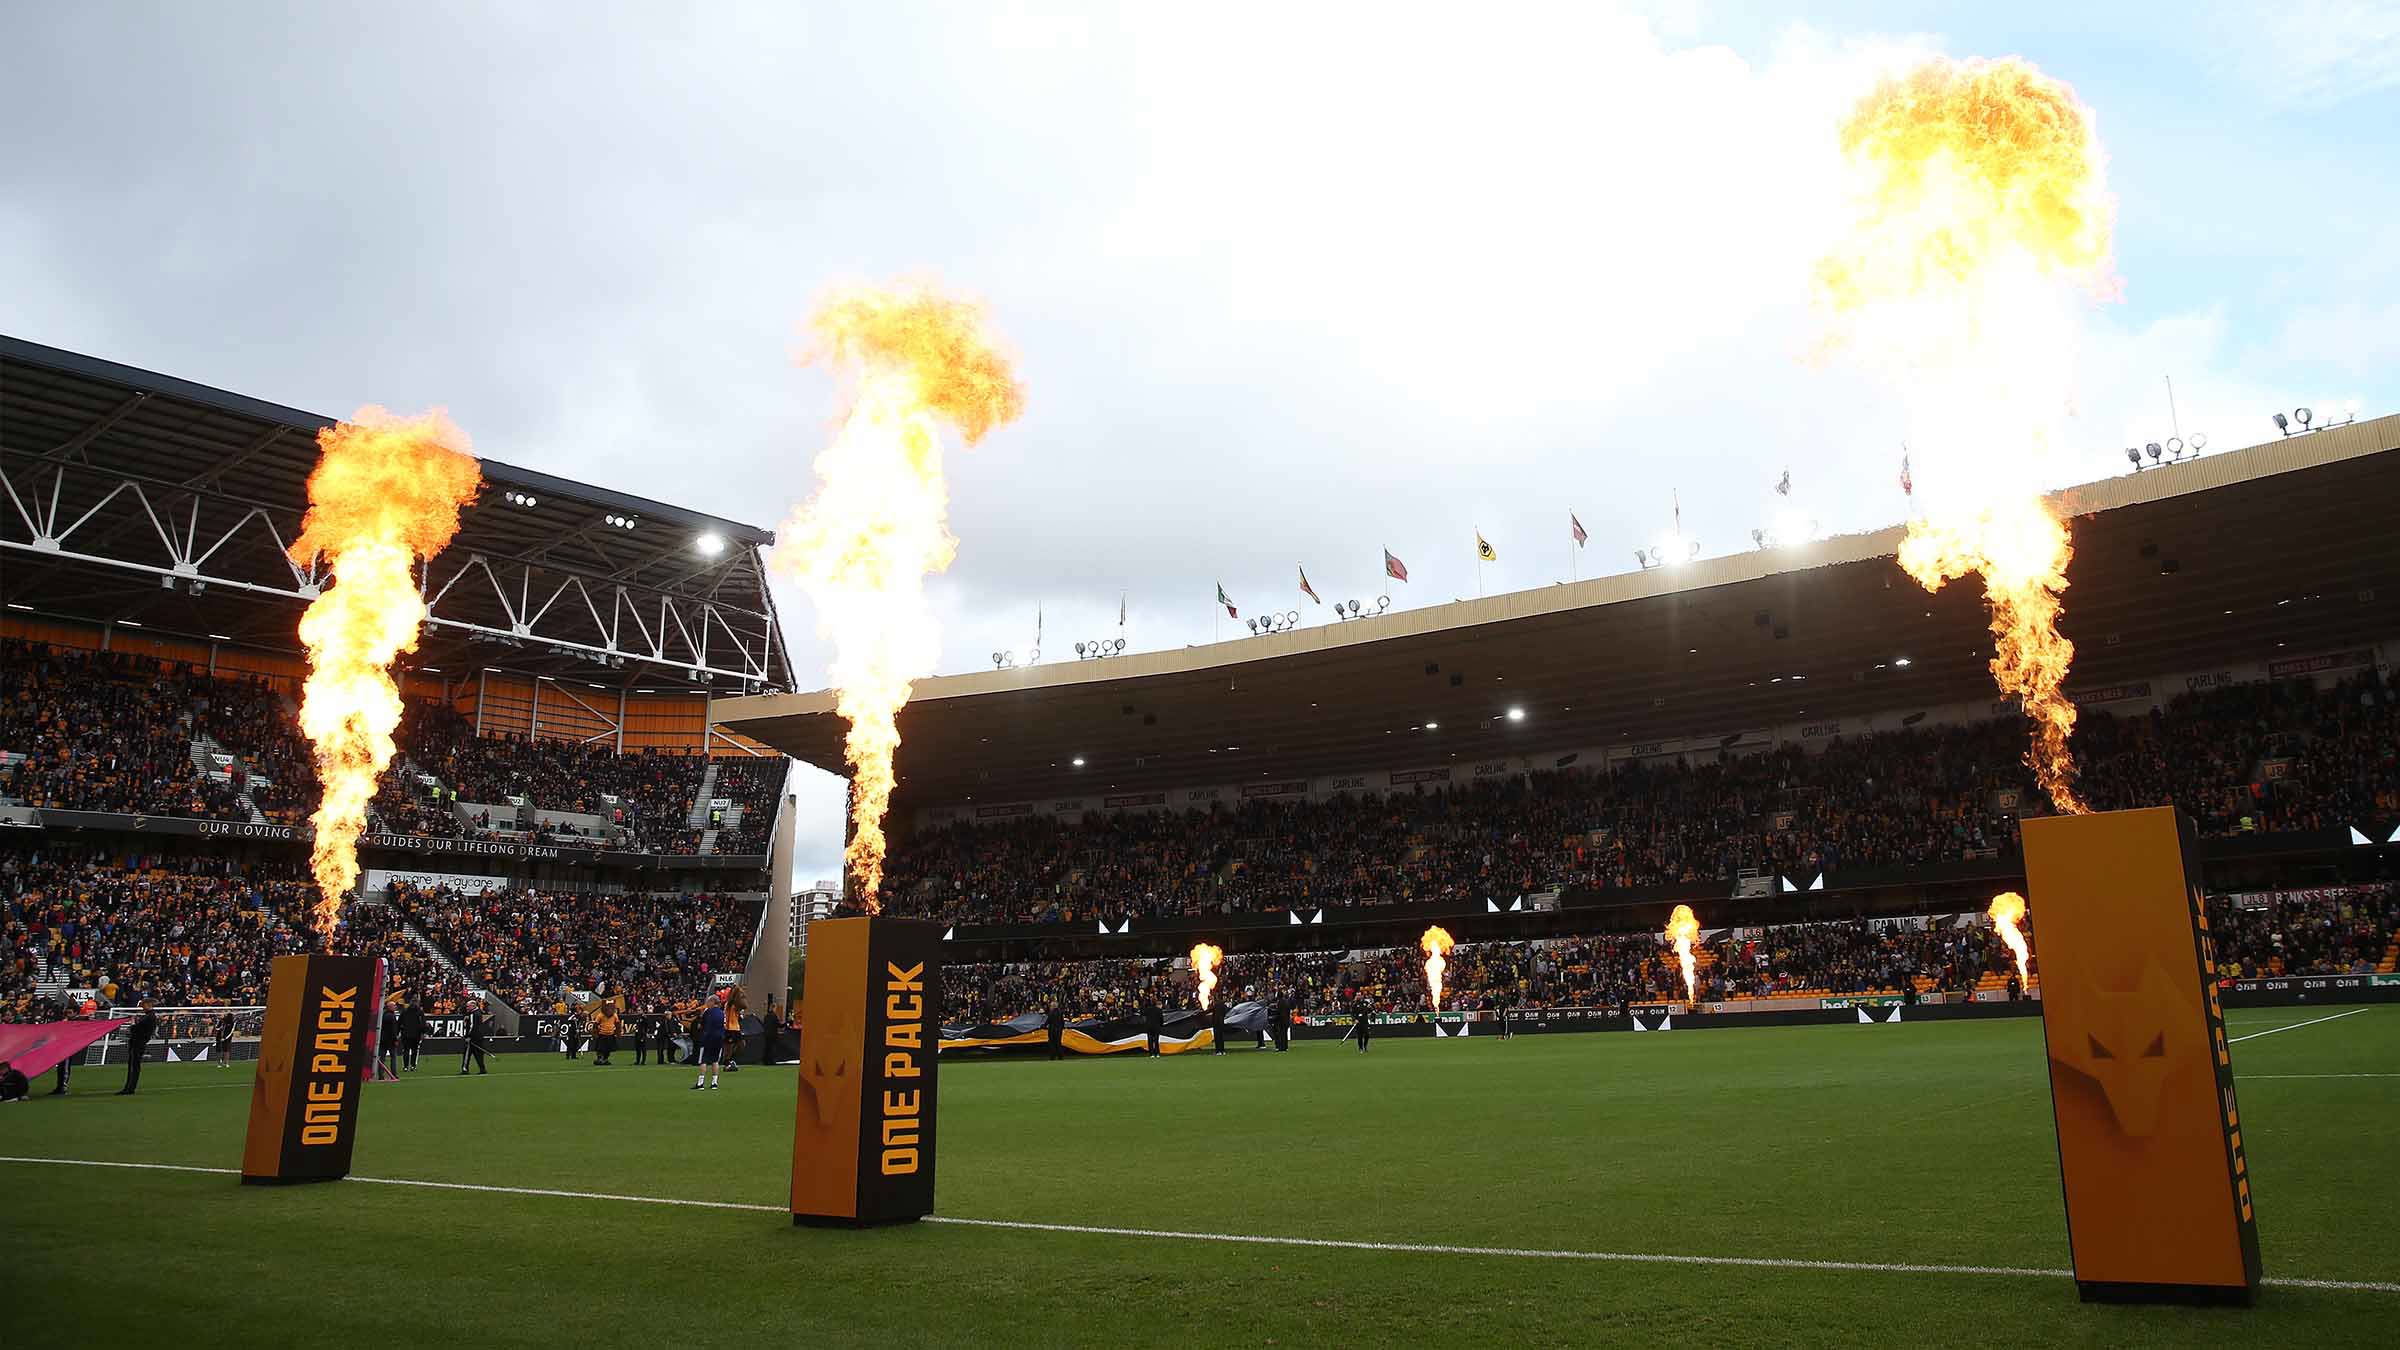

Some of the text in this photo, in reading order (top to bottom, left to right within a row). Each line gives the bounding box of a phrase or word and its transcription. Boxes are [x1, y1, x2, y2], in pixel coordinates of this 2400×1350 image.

[2185, 671, 2232, 688] CARLING
[199, 822, 230, 834] OUR
[237, 824, 291, 839] LOVING
[373, 837, 558, 858] GUIDES OUR LIFELONG DREAM
[302, 985, 358, 1145] ONE PACK
[882, 961, 924, 1175] ONE PACK
